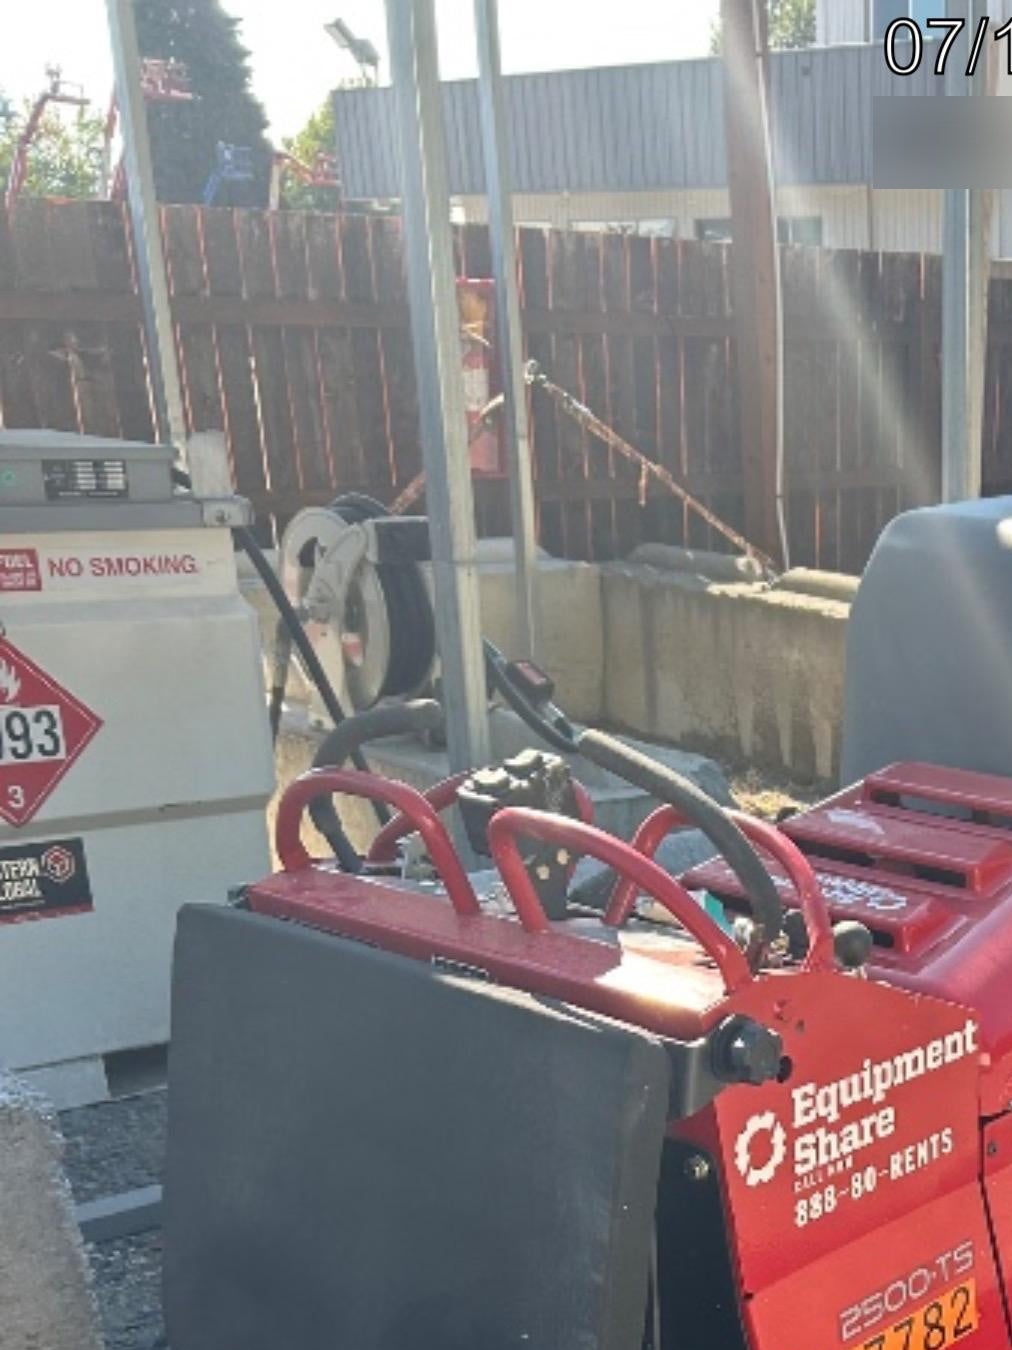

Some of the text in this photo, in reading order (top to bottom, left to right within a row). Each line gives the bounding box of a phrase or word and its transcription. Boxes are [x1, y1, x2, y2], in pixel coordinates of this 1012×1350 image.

[49, 554, 198, 578] NO SMOKING
[0, 709, 60, 760] 93
[8, 785, 24, 809] 3
[0, 858, 40, 881] TERN
[791, 1019, 978, 1129] Equipment
[794, 1106, 895, 1175] Share
[794, 1126, 953, 1228] 888-80-RENTS
